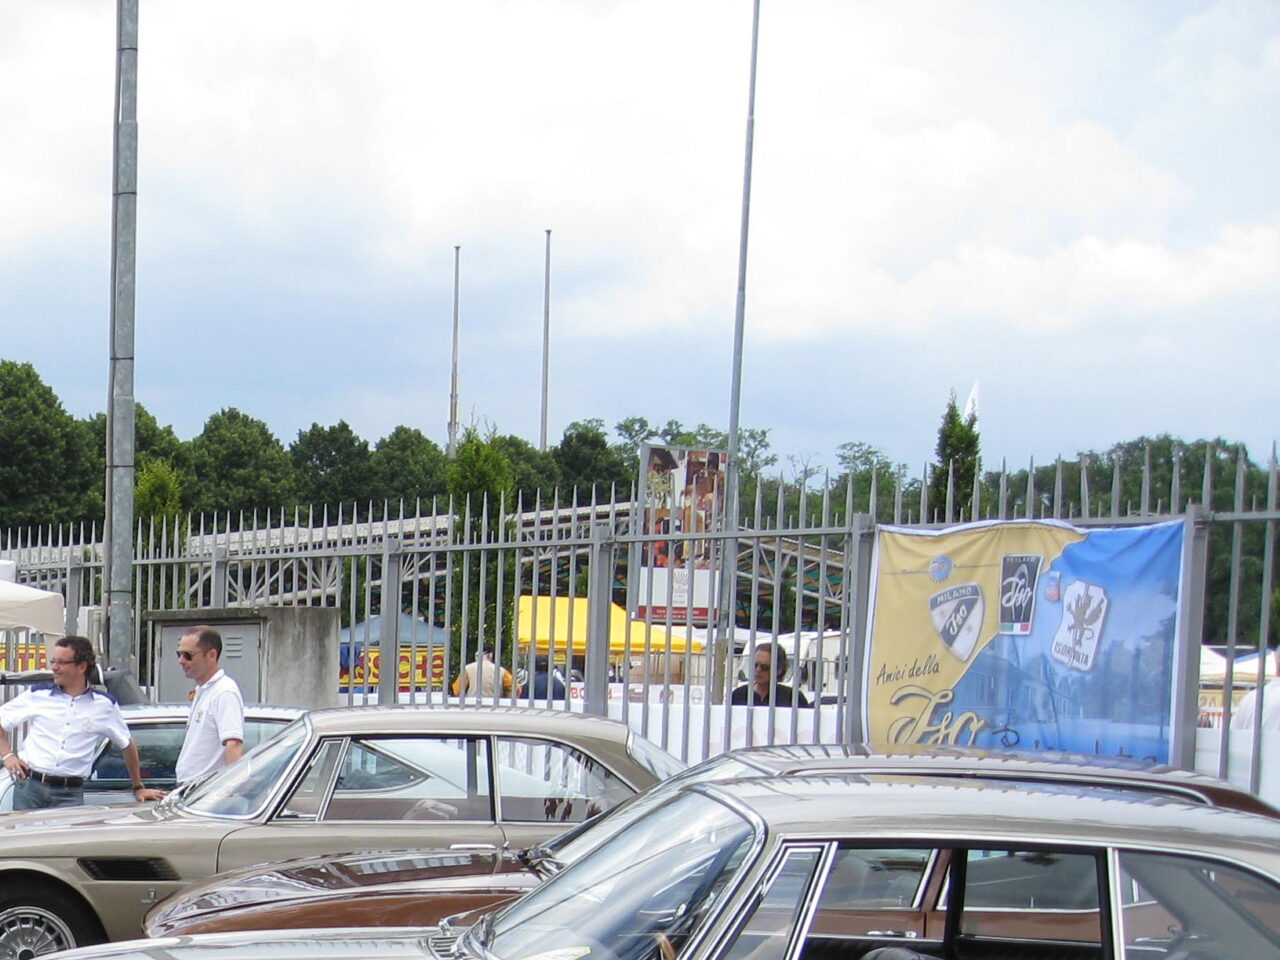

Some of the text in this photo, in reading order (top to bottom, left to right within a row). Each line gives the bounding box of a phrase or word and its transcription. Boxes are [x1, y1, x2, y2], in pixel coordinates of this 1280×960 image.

[937, 587, 972, 605] MILANO
[876, 654, 940, 686] Amici della
